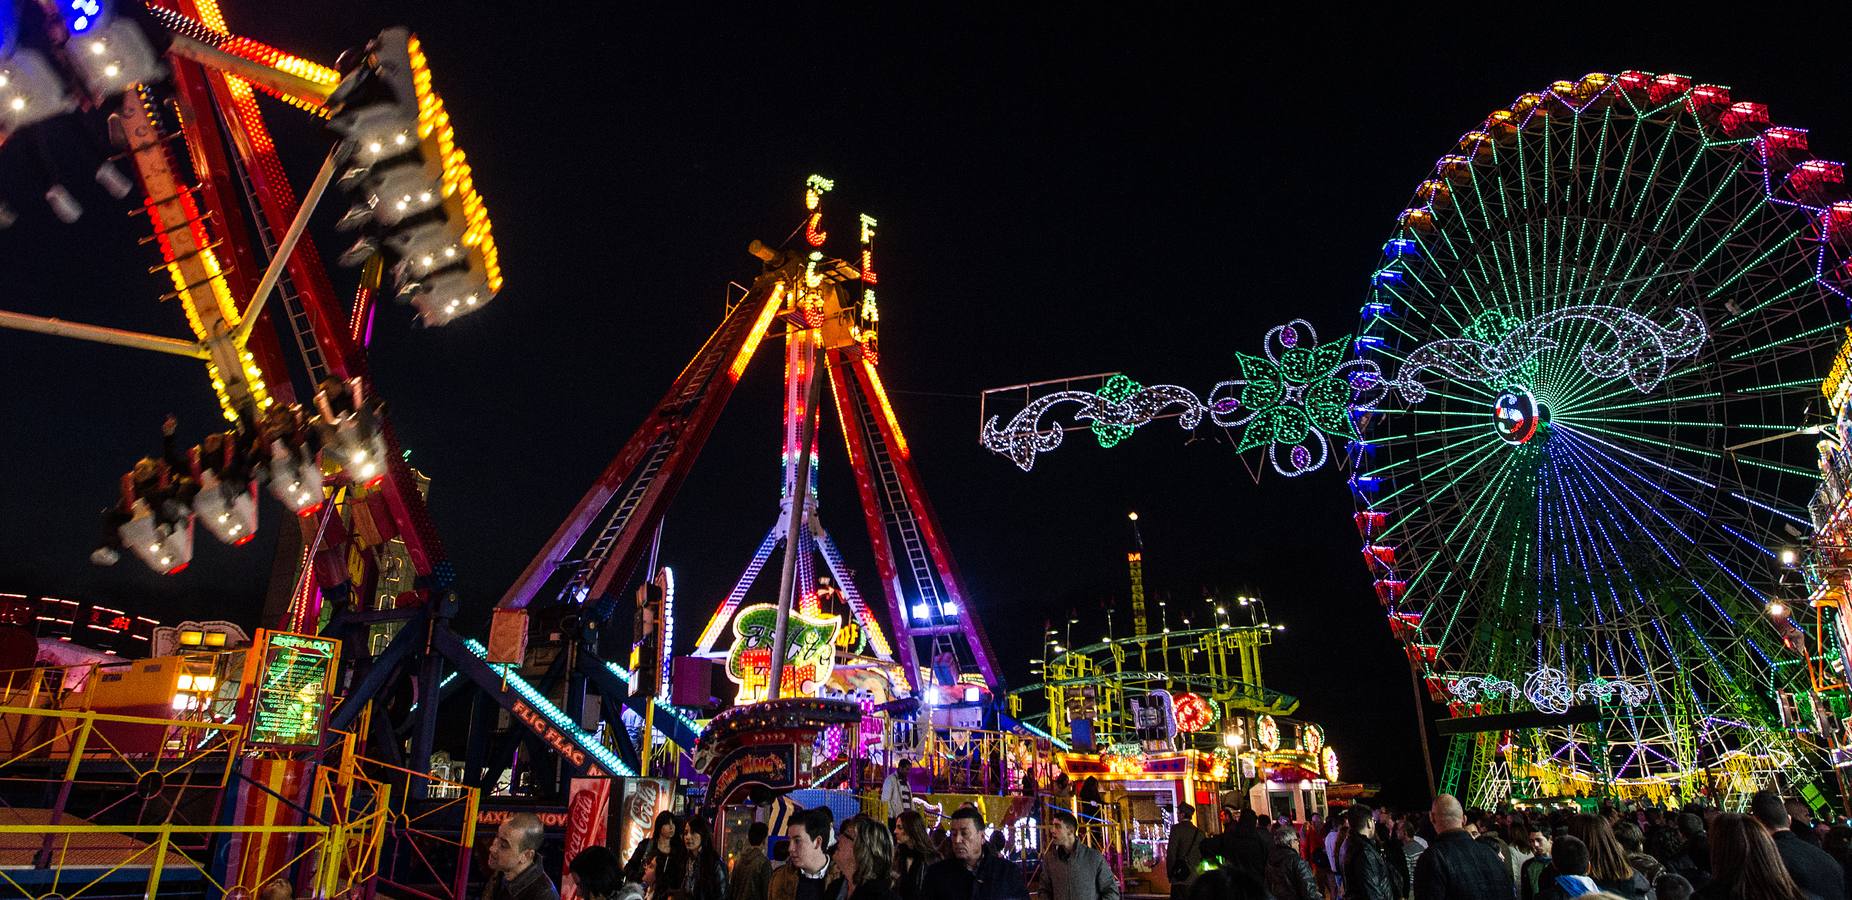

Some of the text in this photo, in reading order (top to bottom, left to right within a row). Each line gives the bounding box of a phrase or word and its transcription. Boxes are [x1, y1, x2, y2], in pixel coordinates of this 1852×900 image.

[859, 213, 880, 367] FLAC
[271, 636, 331, 652] ENTRADA
[511, 699, 587, 767] FLIC FLAC
[536, 813, 568, 826] NOV
